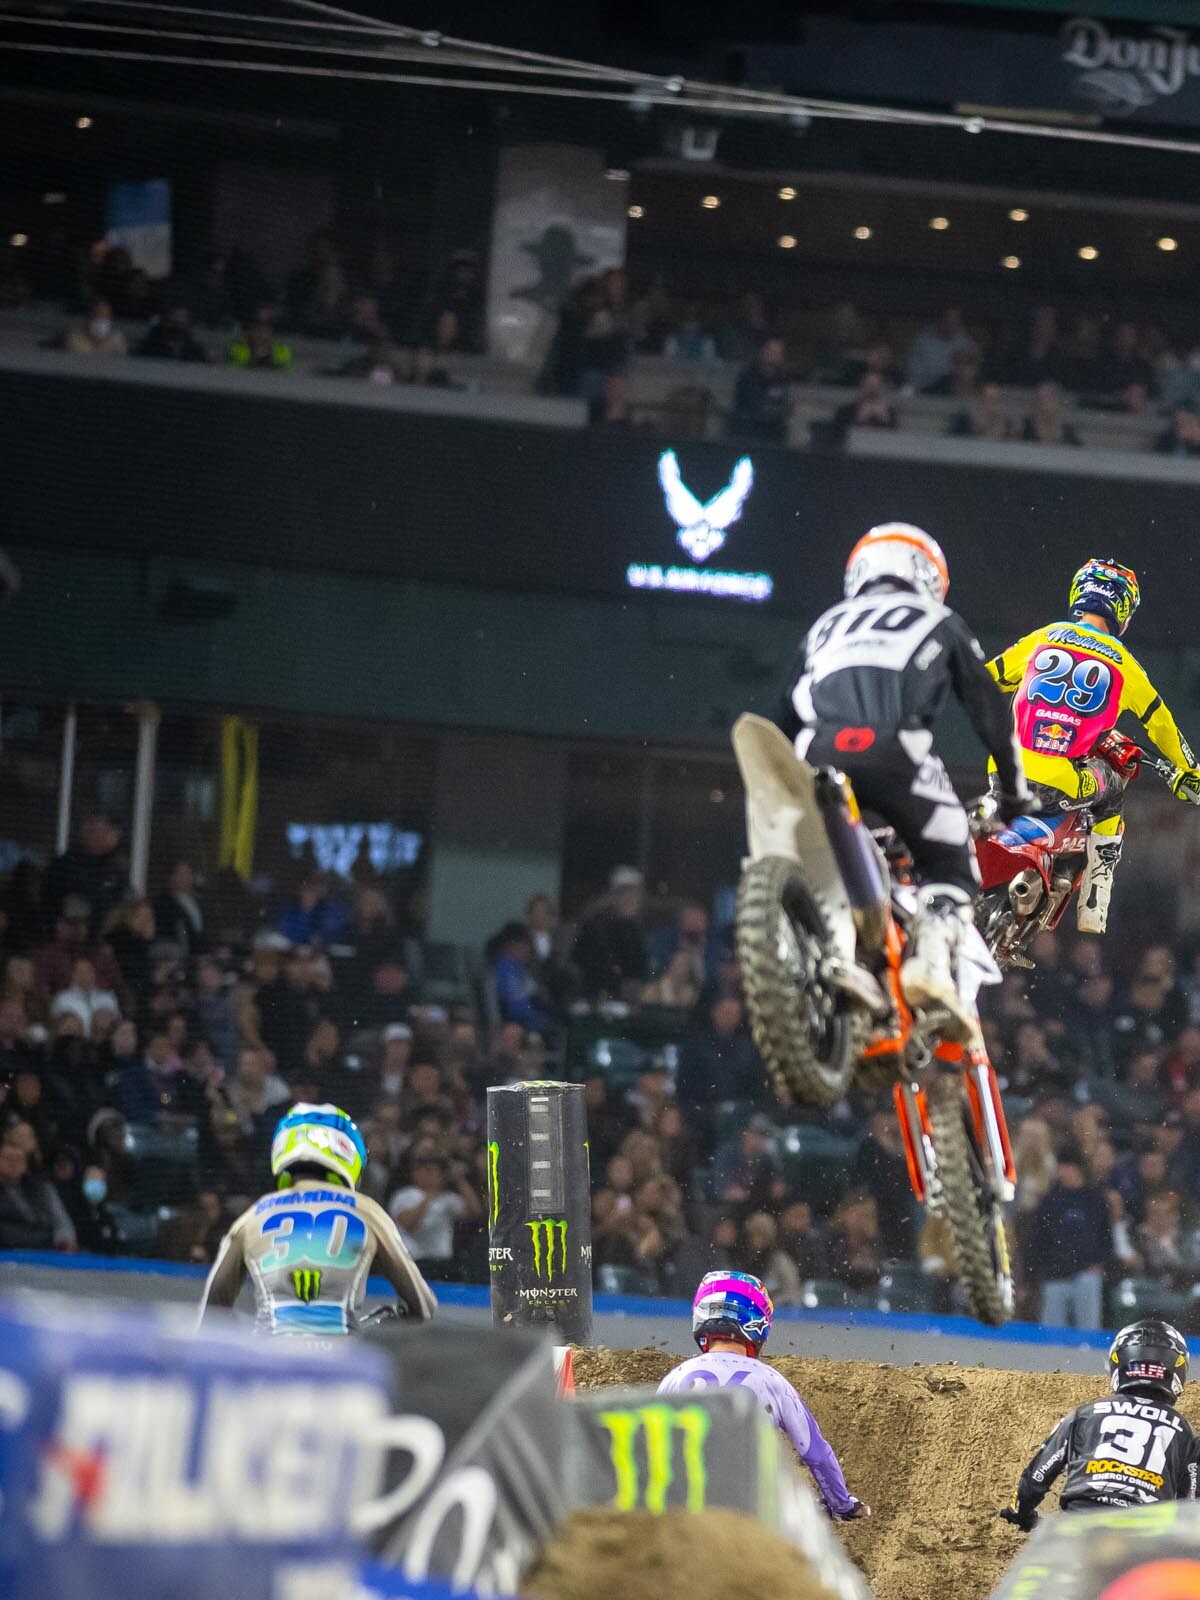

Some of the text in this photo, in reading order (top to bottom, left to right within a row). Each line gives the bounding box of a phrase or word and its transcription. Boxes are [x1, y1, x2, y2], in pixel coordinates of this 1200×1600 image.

[1082, 581, 1116, 599] Michael
[1027, 648, 1111, 712] 29
[1035, 709, 1082, 726] GASGAS
[260, 1208, 368, 1275] 30
[518, 1287, 578, 1299] MONSTER
[1093, 1401, 1183, 1432] SWOLL
[1094, 1414, 1177, 1475] 31
[1085, 1460, 1165, 1489] ROCKSTAR
[1091, 1473, 1157, 1493] ENERGY DRINK
